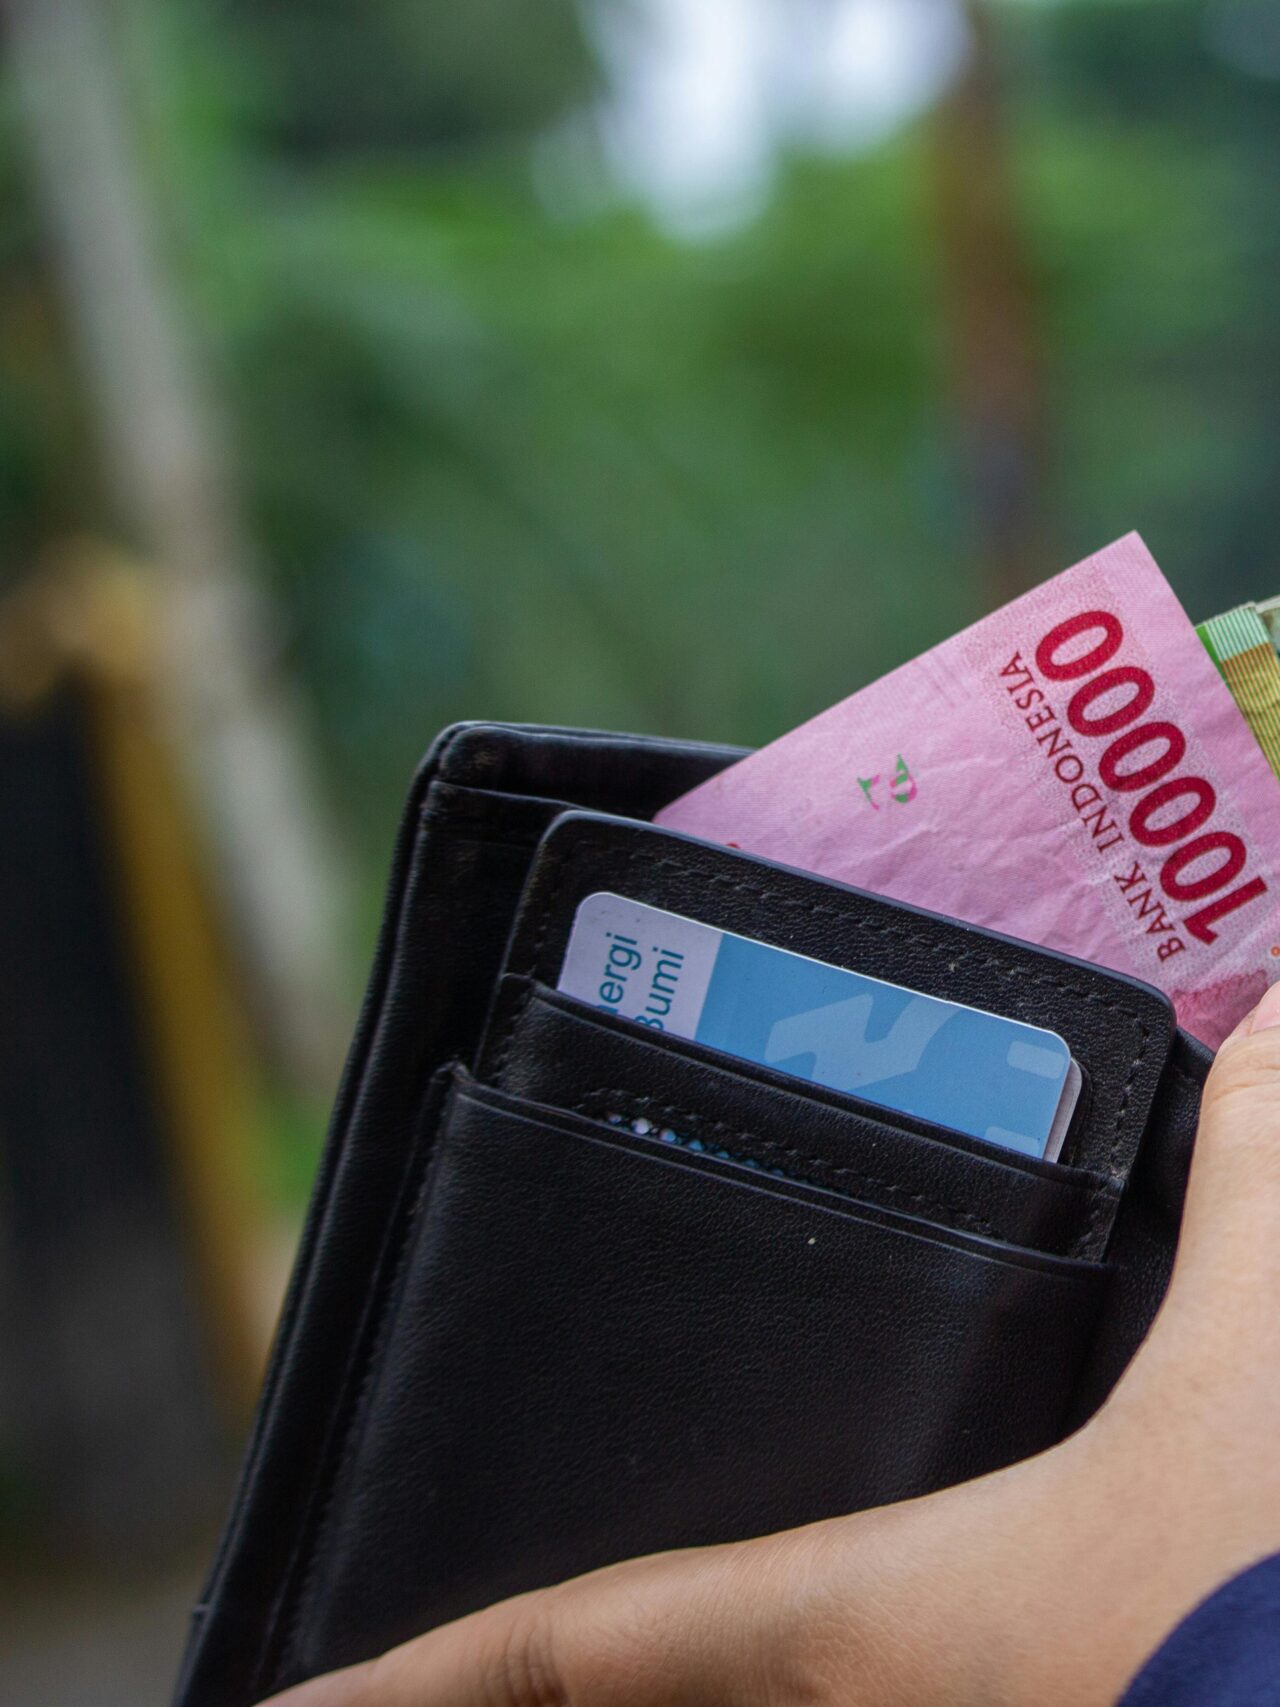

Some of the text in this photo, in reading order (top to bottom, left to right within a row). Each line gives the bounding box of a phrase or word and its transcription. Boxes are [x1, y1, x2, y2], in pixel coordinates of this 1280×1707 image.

[1000, 640, 1186, 963] BANK INDONESIA
[1035, 610, 1268, 946] 100000
